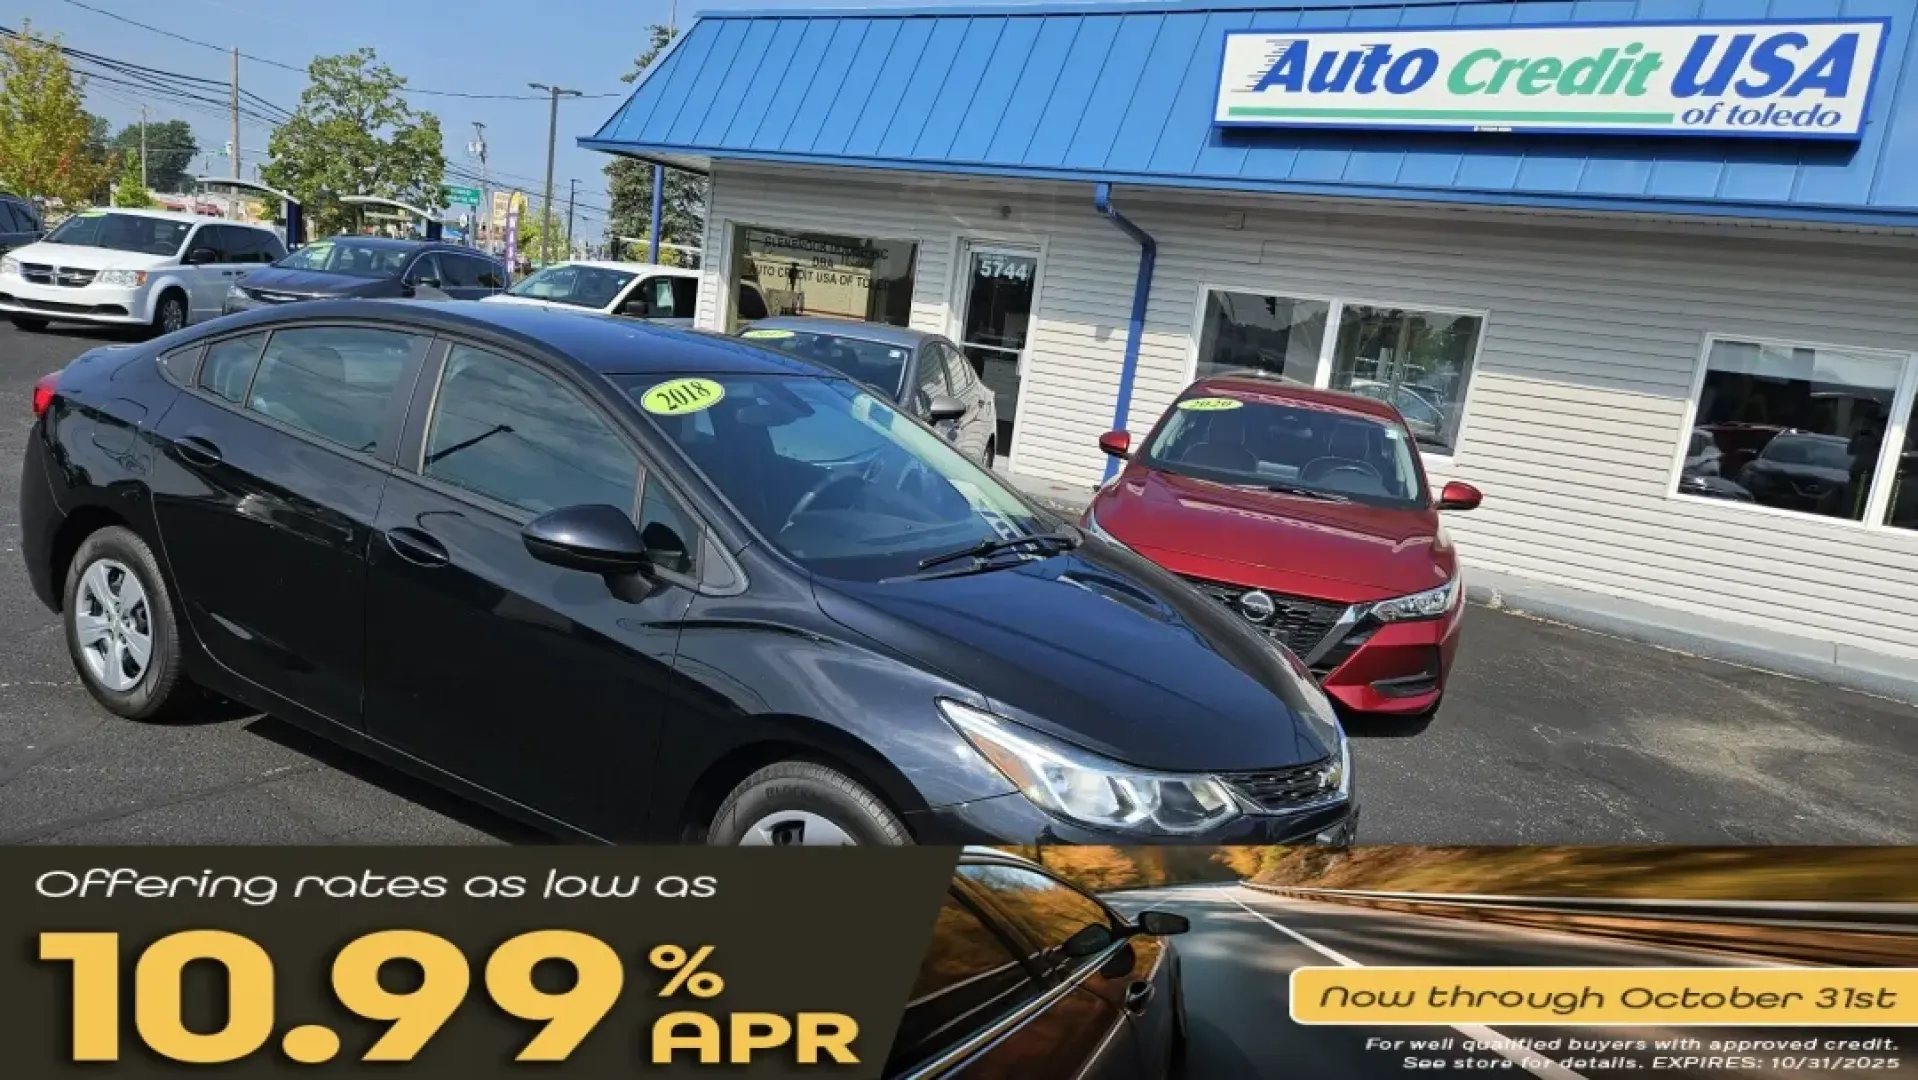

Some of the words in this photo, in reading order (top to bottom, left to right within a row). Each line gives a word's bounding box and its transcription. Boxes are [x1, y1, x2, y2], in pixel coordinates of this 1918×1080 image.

[1251, 38, 1439, 94] Auto
[1447, 42, 1664, 97] Credit
[1671, 31, 1860, 98] USA
[1681, 102, 1724, 125] of
[1725, 103, 1842, 127] toledo
[816, 272, 838, 285] USA
[839, 274, 853, 286] OF
[980, 260, 1028, 281] 5744
[656, 381, 711, 411] 2018
